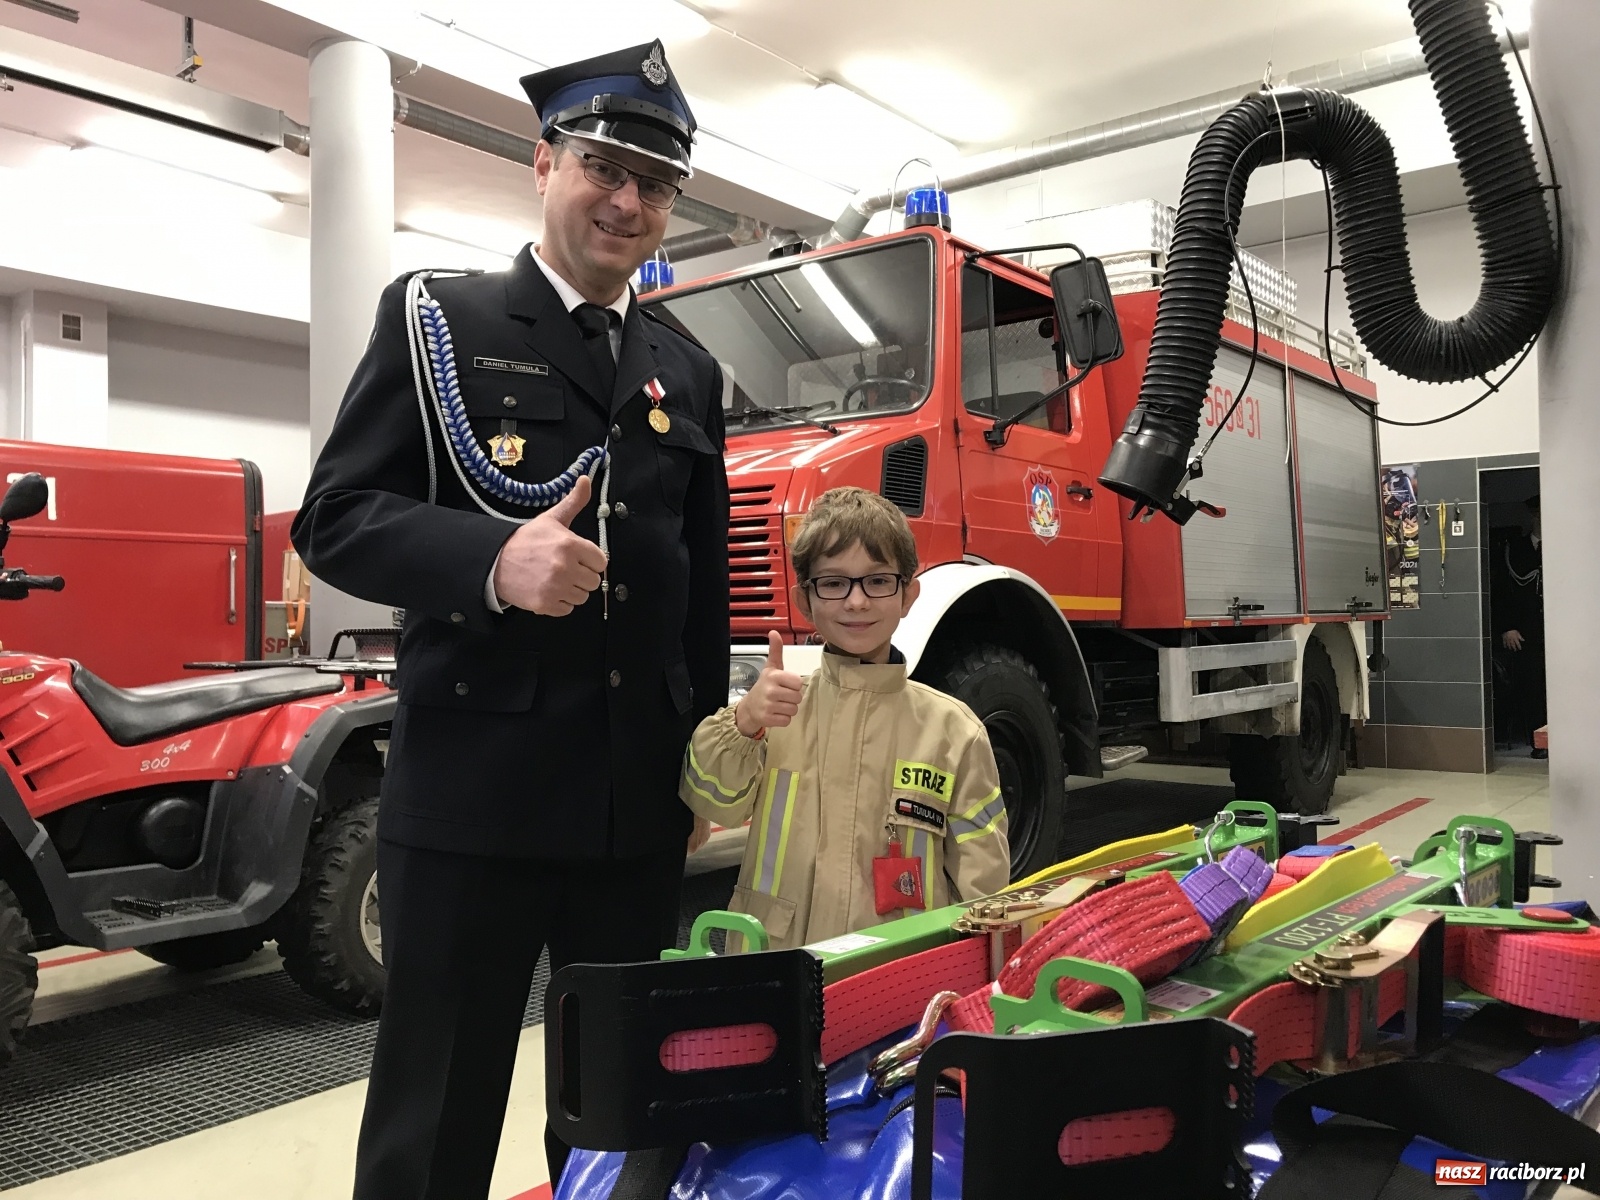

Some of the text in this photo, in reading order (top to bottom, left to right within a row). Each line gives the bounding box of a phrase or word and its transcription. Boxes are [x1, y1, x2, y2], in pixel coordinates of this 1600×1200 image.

[483, 360, 540, 372] DANIEL TUMULA
[1029, 471, 1052, 486] OSP
[1400, 561, 1418, 569] 2021
[163, 739, 192, 754] 4x4
[140, 756, 170, 772] 300
